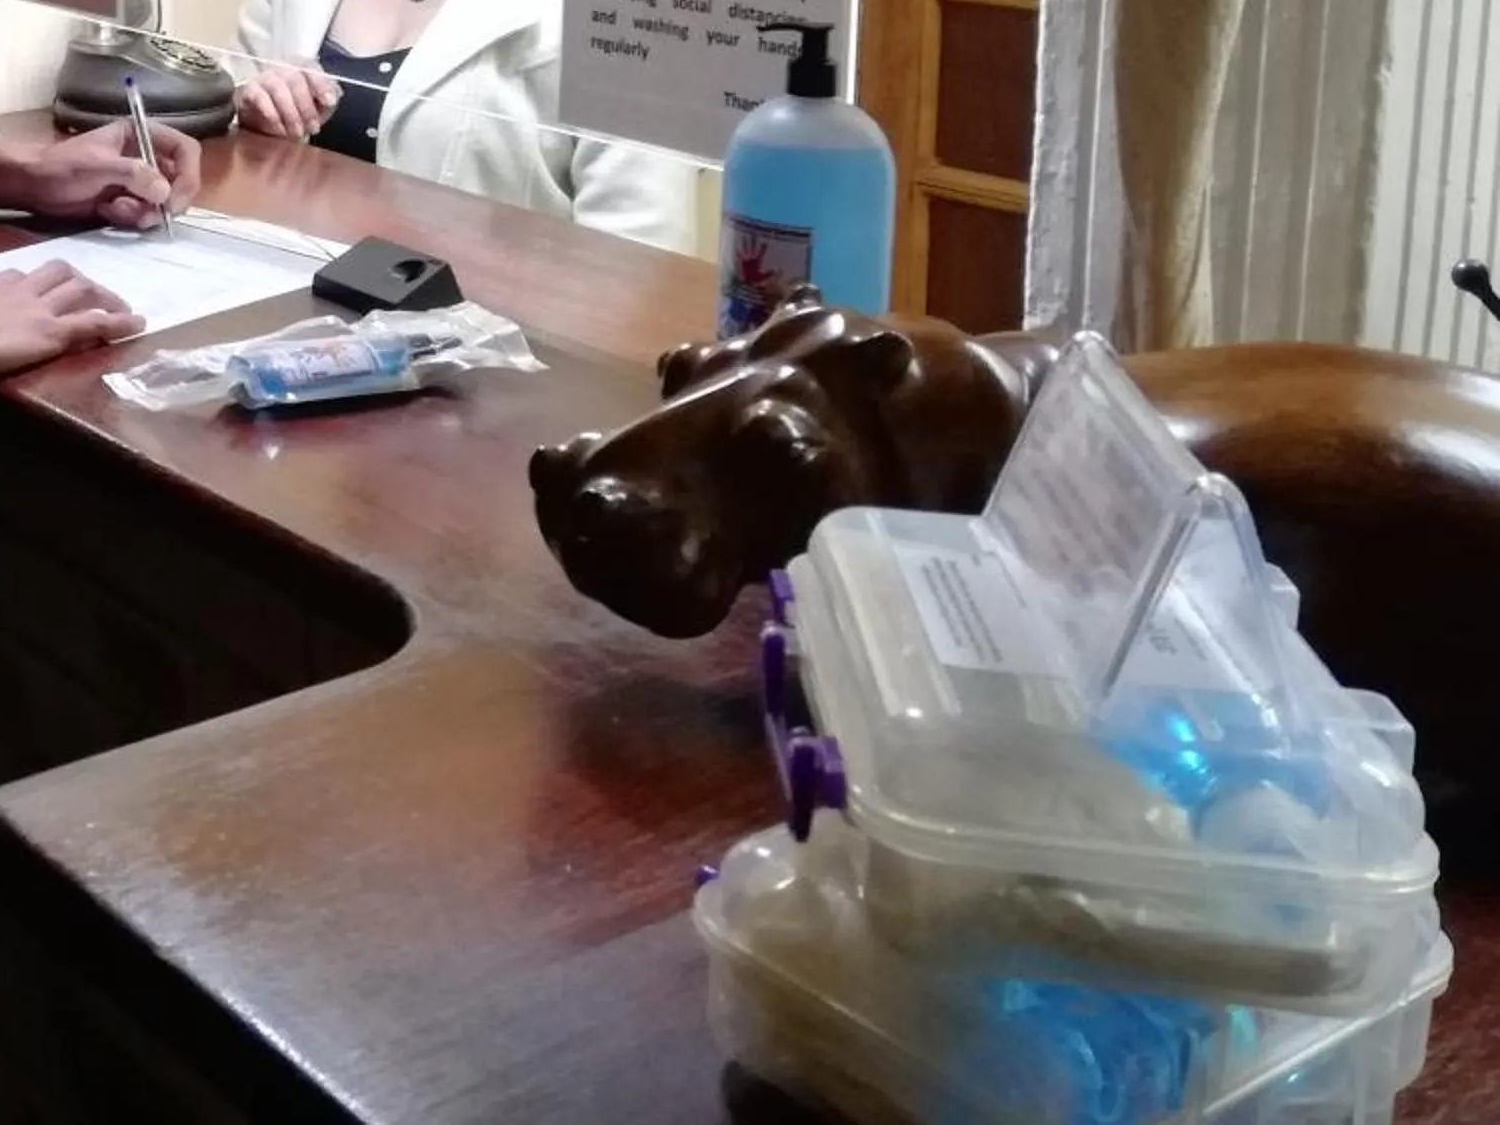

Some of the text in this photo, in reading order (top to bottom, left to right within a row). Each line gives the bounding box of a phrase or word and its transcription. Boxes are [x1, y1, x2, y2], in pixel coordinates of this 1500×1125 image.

[591, 10, 618, 27] and
[632, 18, 690, 43] washing
[706, 29, 740, 48] your
[590, 37, 651, 61] regularly
[723, 90, 765, 113] Than
